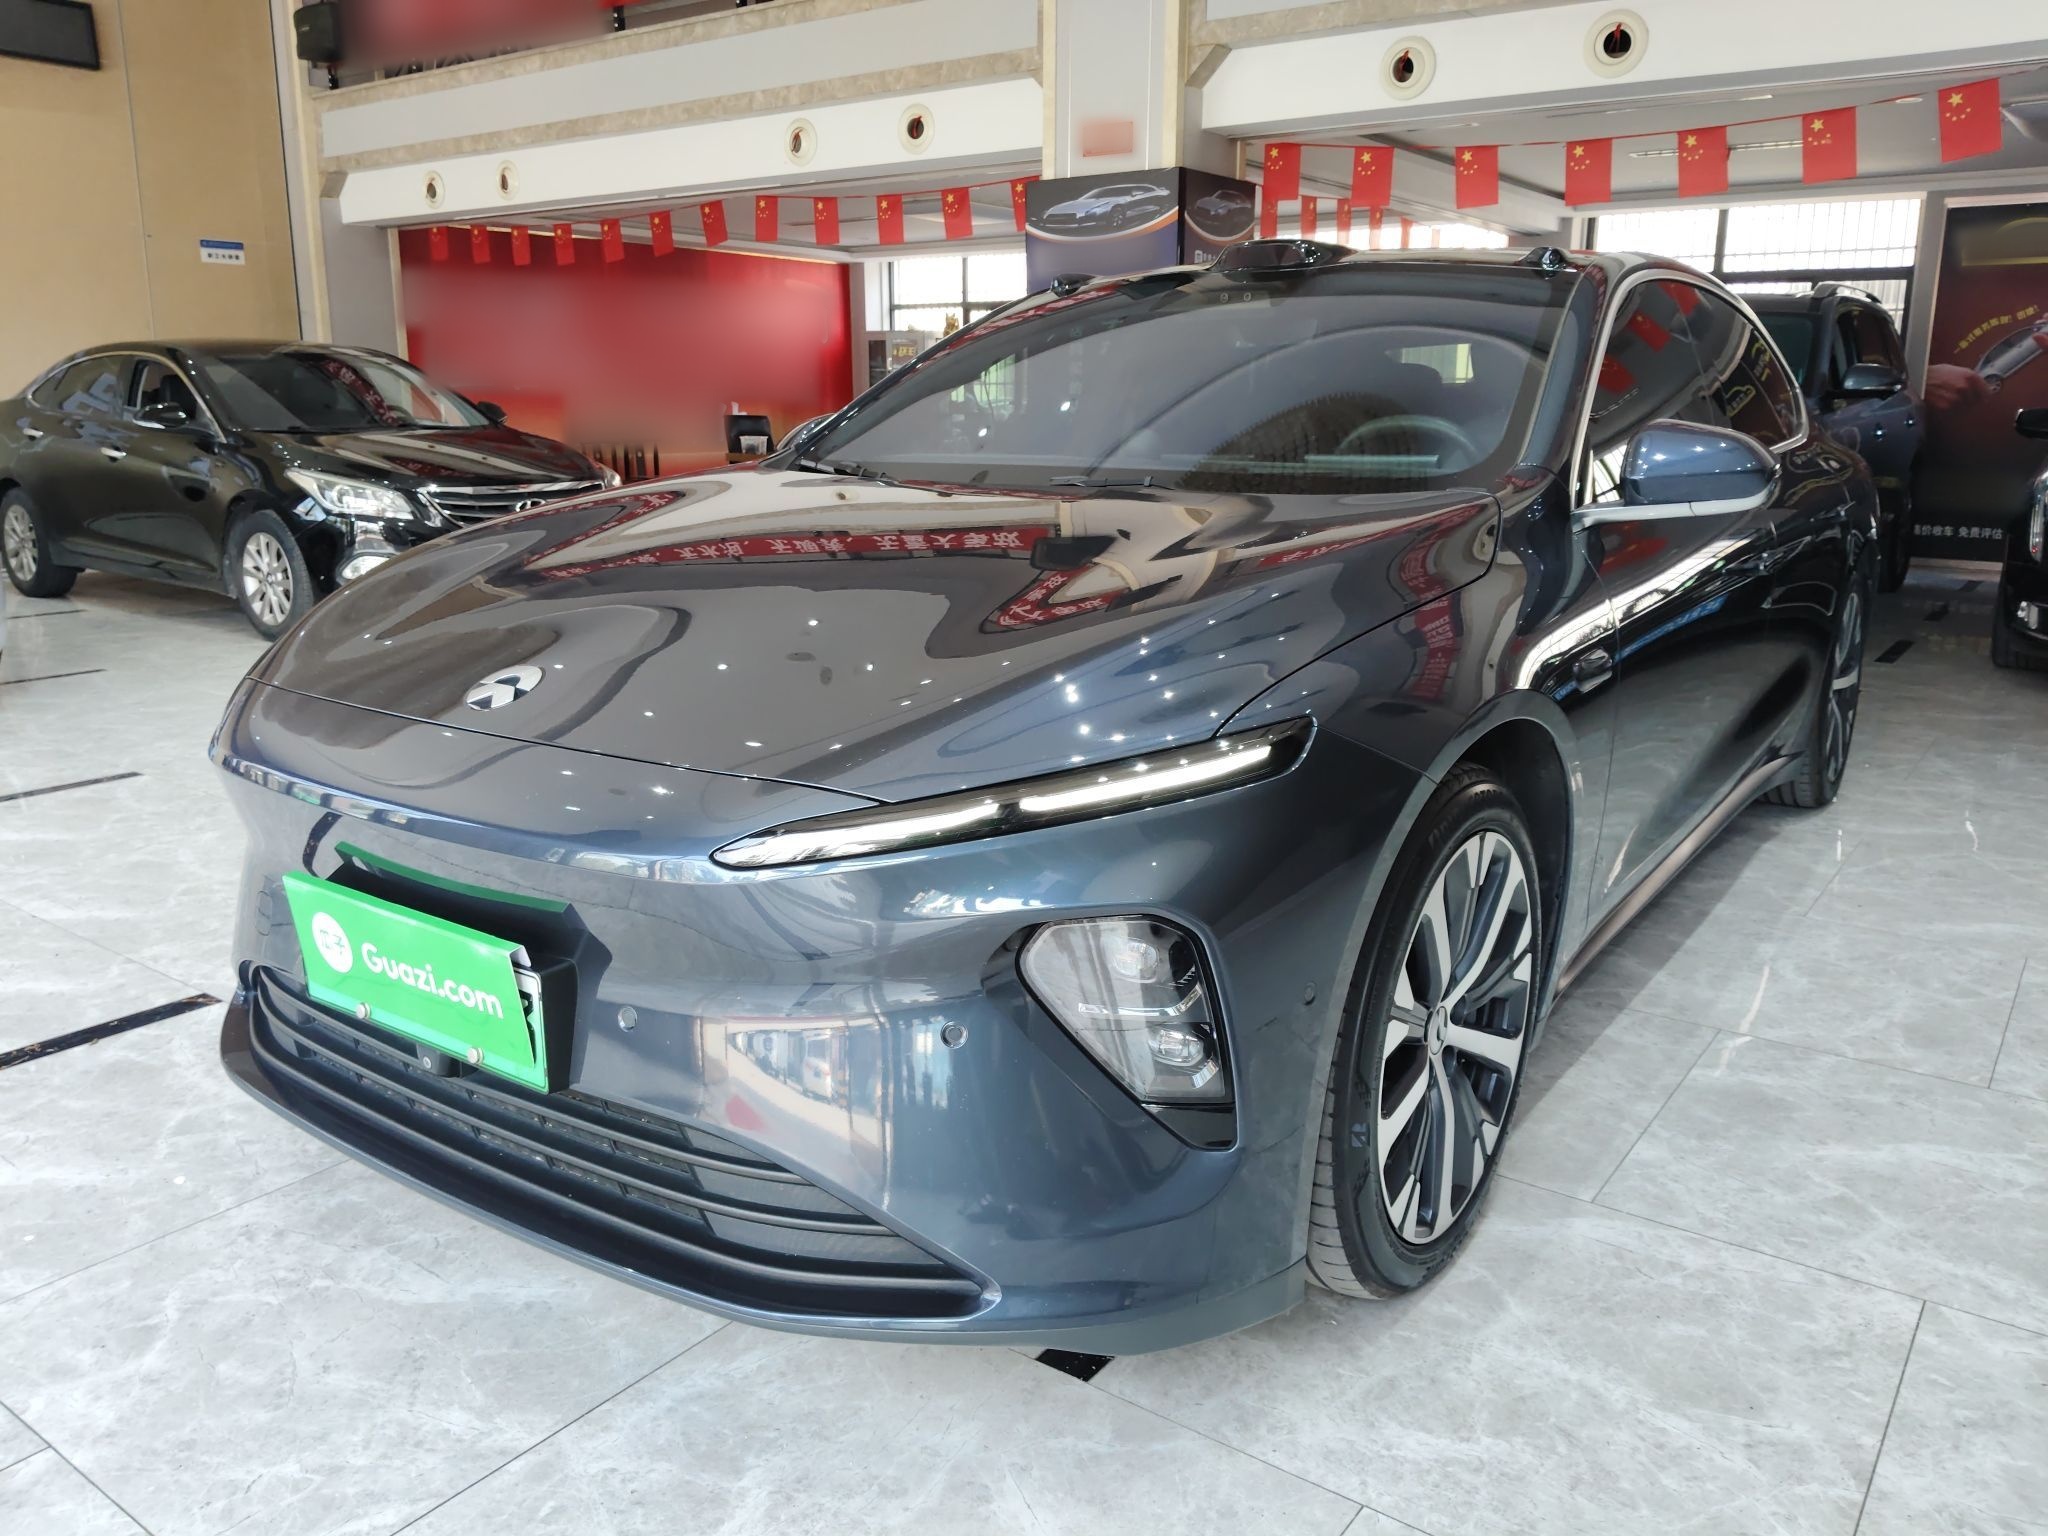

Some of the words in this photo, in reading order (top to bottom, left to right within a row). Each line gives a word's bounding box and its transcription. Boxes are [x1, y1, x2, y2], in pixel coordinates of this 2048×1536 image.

[1958, 526, 2003, 540] 免费评估
[361, 942, 504, 1019] Guazi.com
